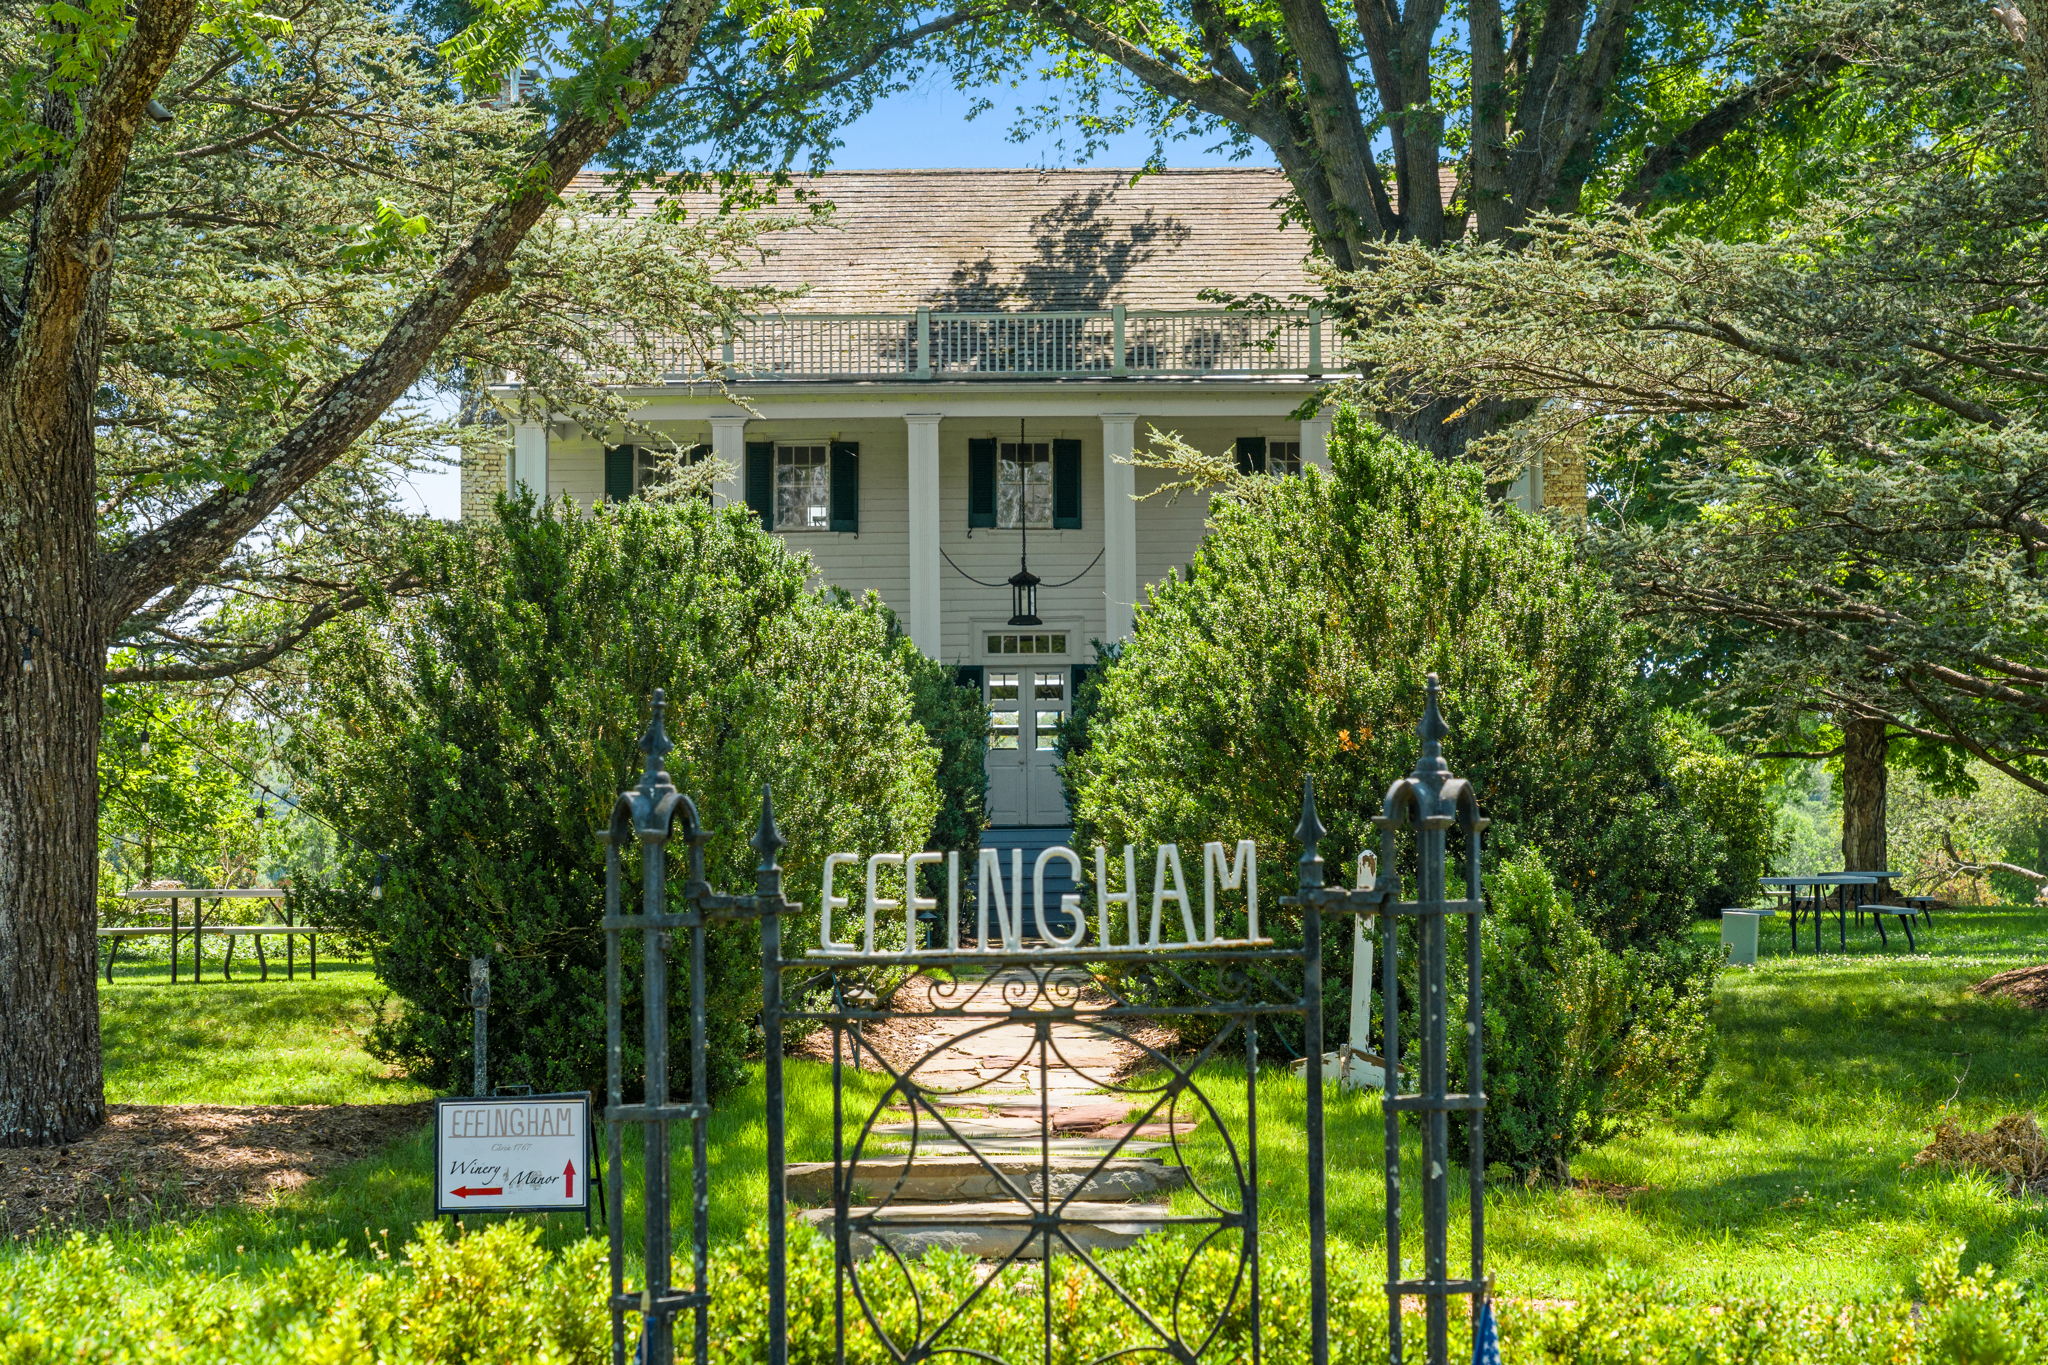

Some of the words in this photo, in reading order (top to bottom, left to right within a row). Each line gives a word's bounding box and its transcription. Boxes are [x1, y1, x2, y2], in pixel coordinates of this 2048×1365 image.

[823, 840, 1258, 954] EFFINGHAM
[452, 1108, 571, 1137] EFFINGHAM
[449, 1159, 502, 1186] Winery
[508, 1170, 560, 1186] Manor
